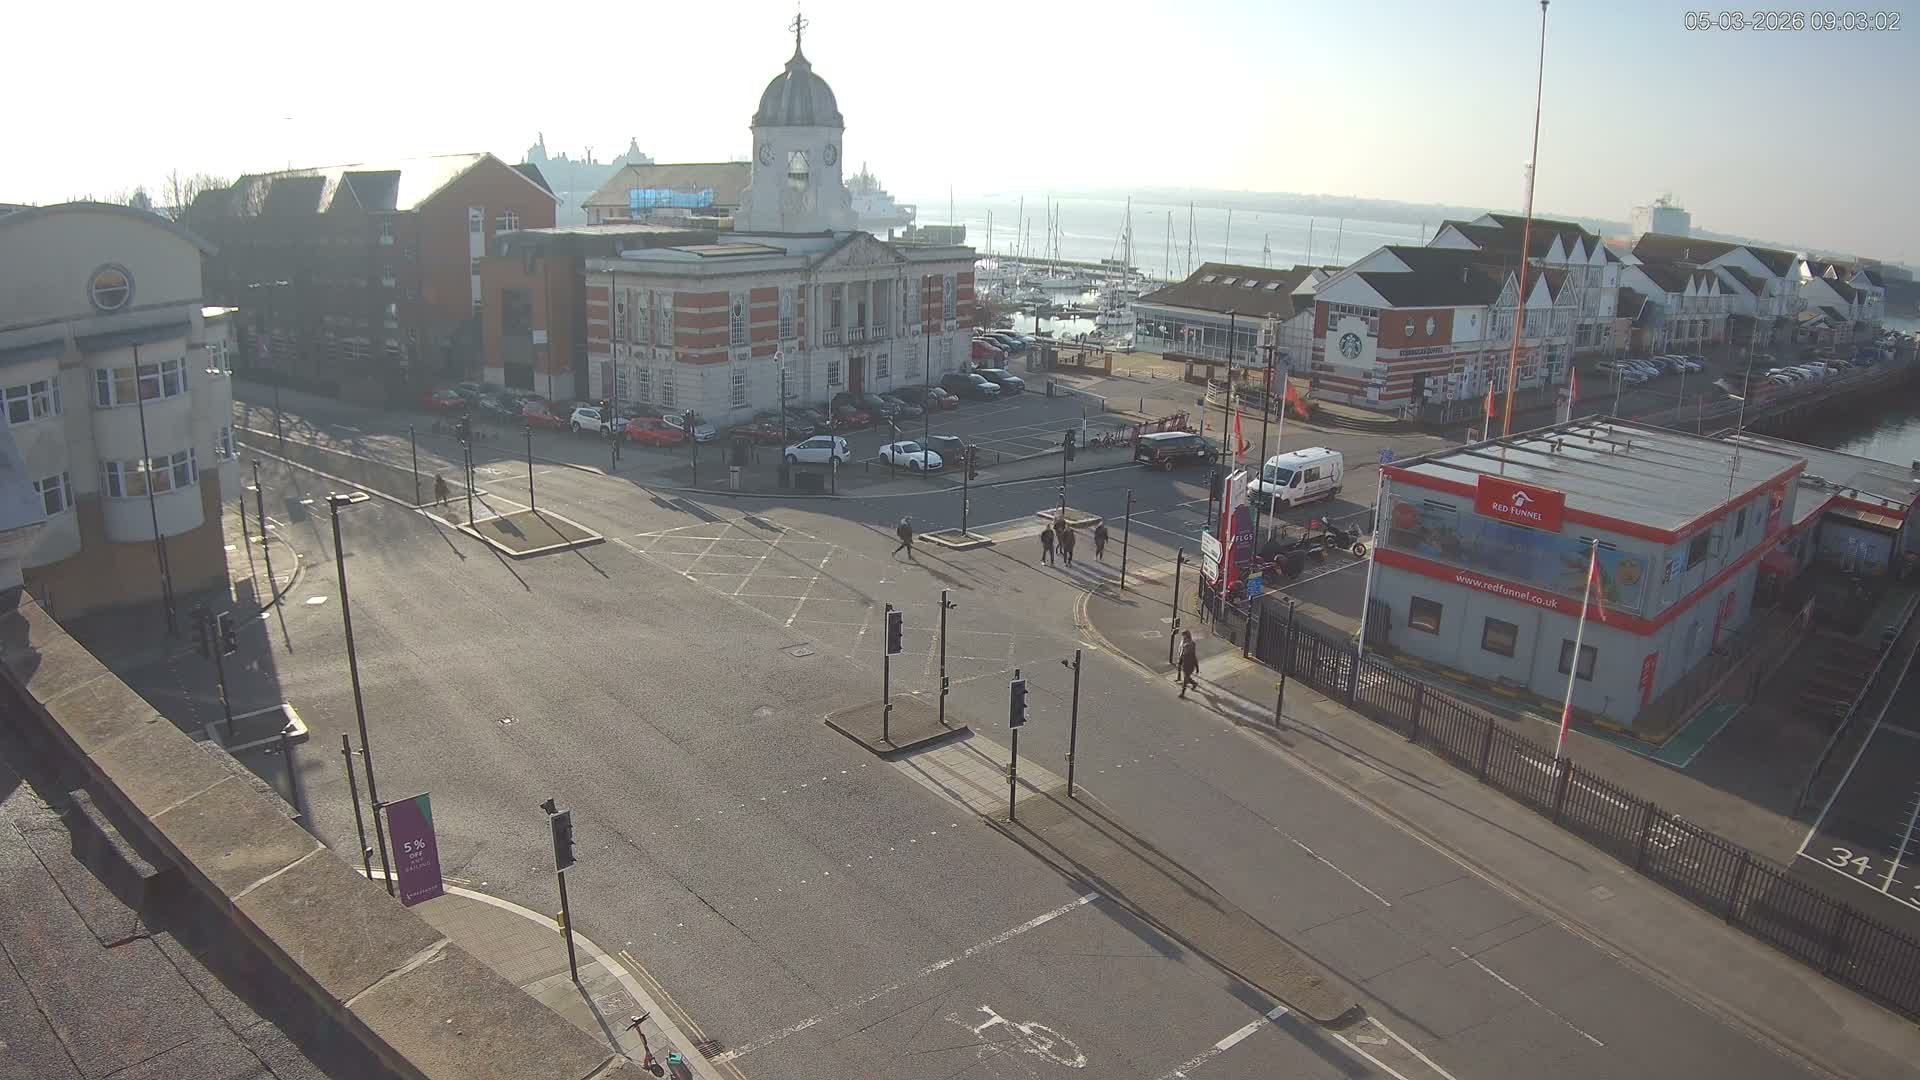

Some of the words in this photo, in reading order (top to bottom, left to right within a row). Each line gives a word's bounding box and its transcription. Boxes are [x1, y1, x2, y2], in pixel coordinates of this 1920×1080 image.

[1492, 501, 1509, 513] RED
[1511, 507, 1543, 521] FUNNEL
[1456, 575, 1558, 608] www.redfunnel.co.uk
[409, 850, 423, 859] OFF
[1826, 847, 1872, 875] 34
